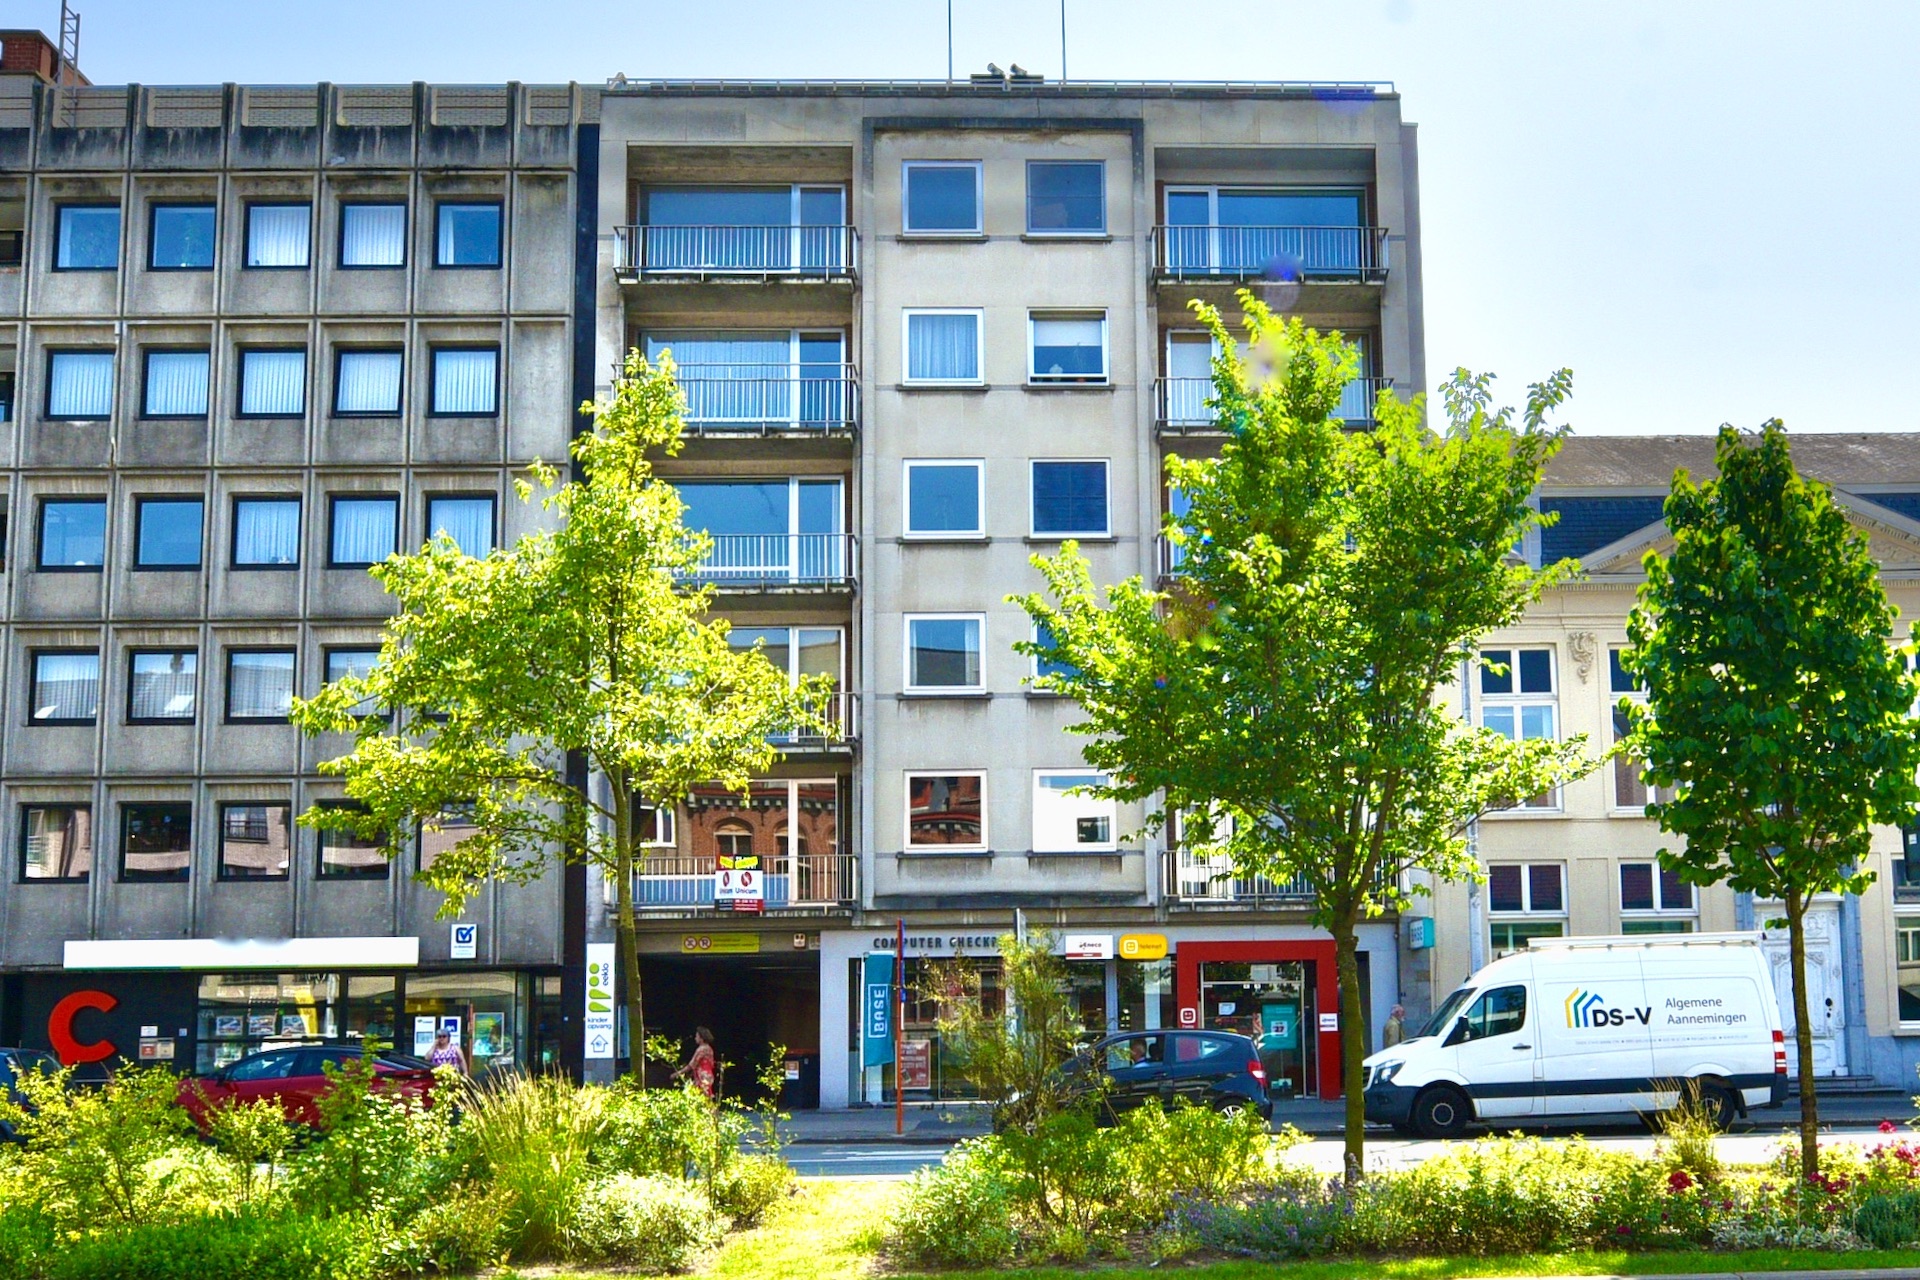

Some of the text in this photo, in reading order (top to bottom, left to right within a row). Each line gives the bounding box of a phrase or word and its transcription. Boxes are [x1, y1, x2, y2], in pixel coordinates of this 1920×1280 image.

[735, 887, 758, 895] Unicum
[1665, 998, 1722, 1010] Algemene
[874, 989, 885, 1033] BASE
[1592, 1007, 1652, 1027] DS-V
[1667, 1013, 1747, 1026] Aannemingen
